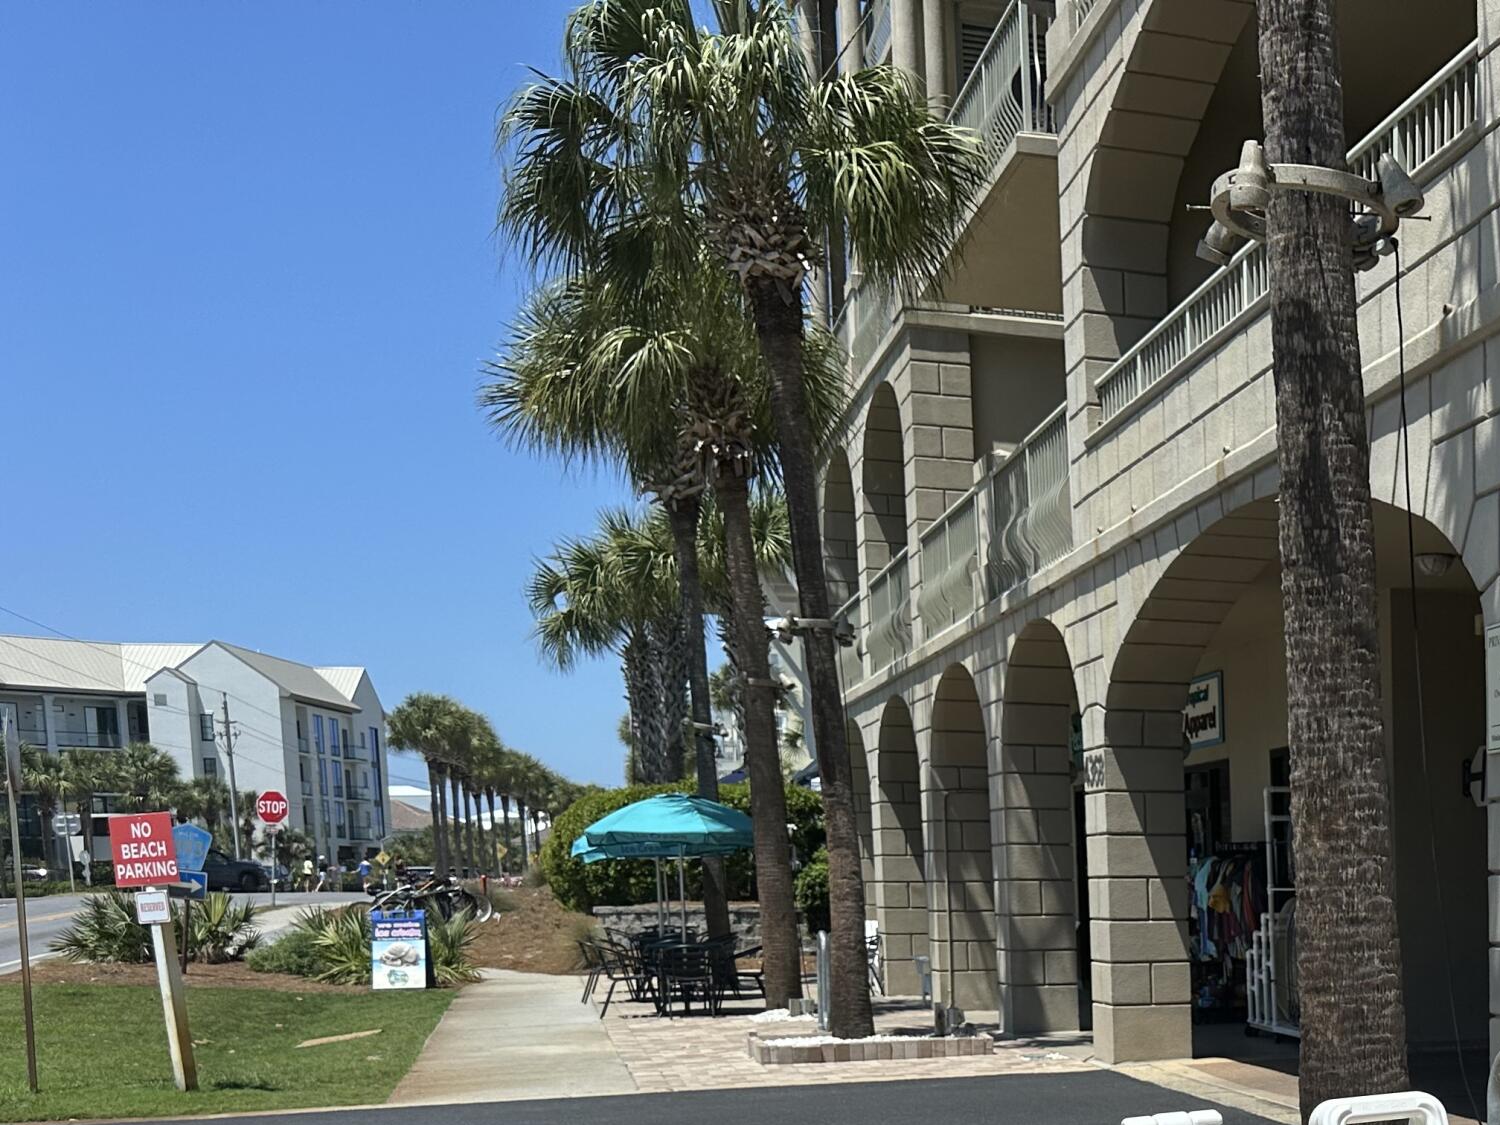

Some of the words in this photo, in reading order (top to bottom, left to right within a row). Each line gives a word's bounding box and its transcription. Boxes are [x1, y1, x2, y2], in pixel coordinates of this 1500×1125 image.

[259, 800, 287, 815] STOP
[131, 822, 152, 839] NO
[121, 841, 168, 860] BEACH
[116, 860, 178, 880] PARKING
